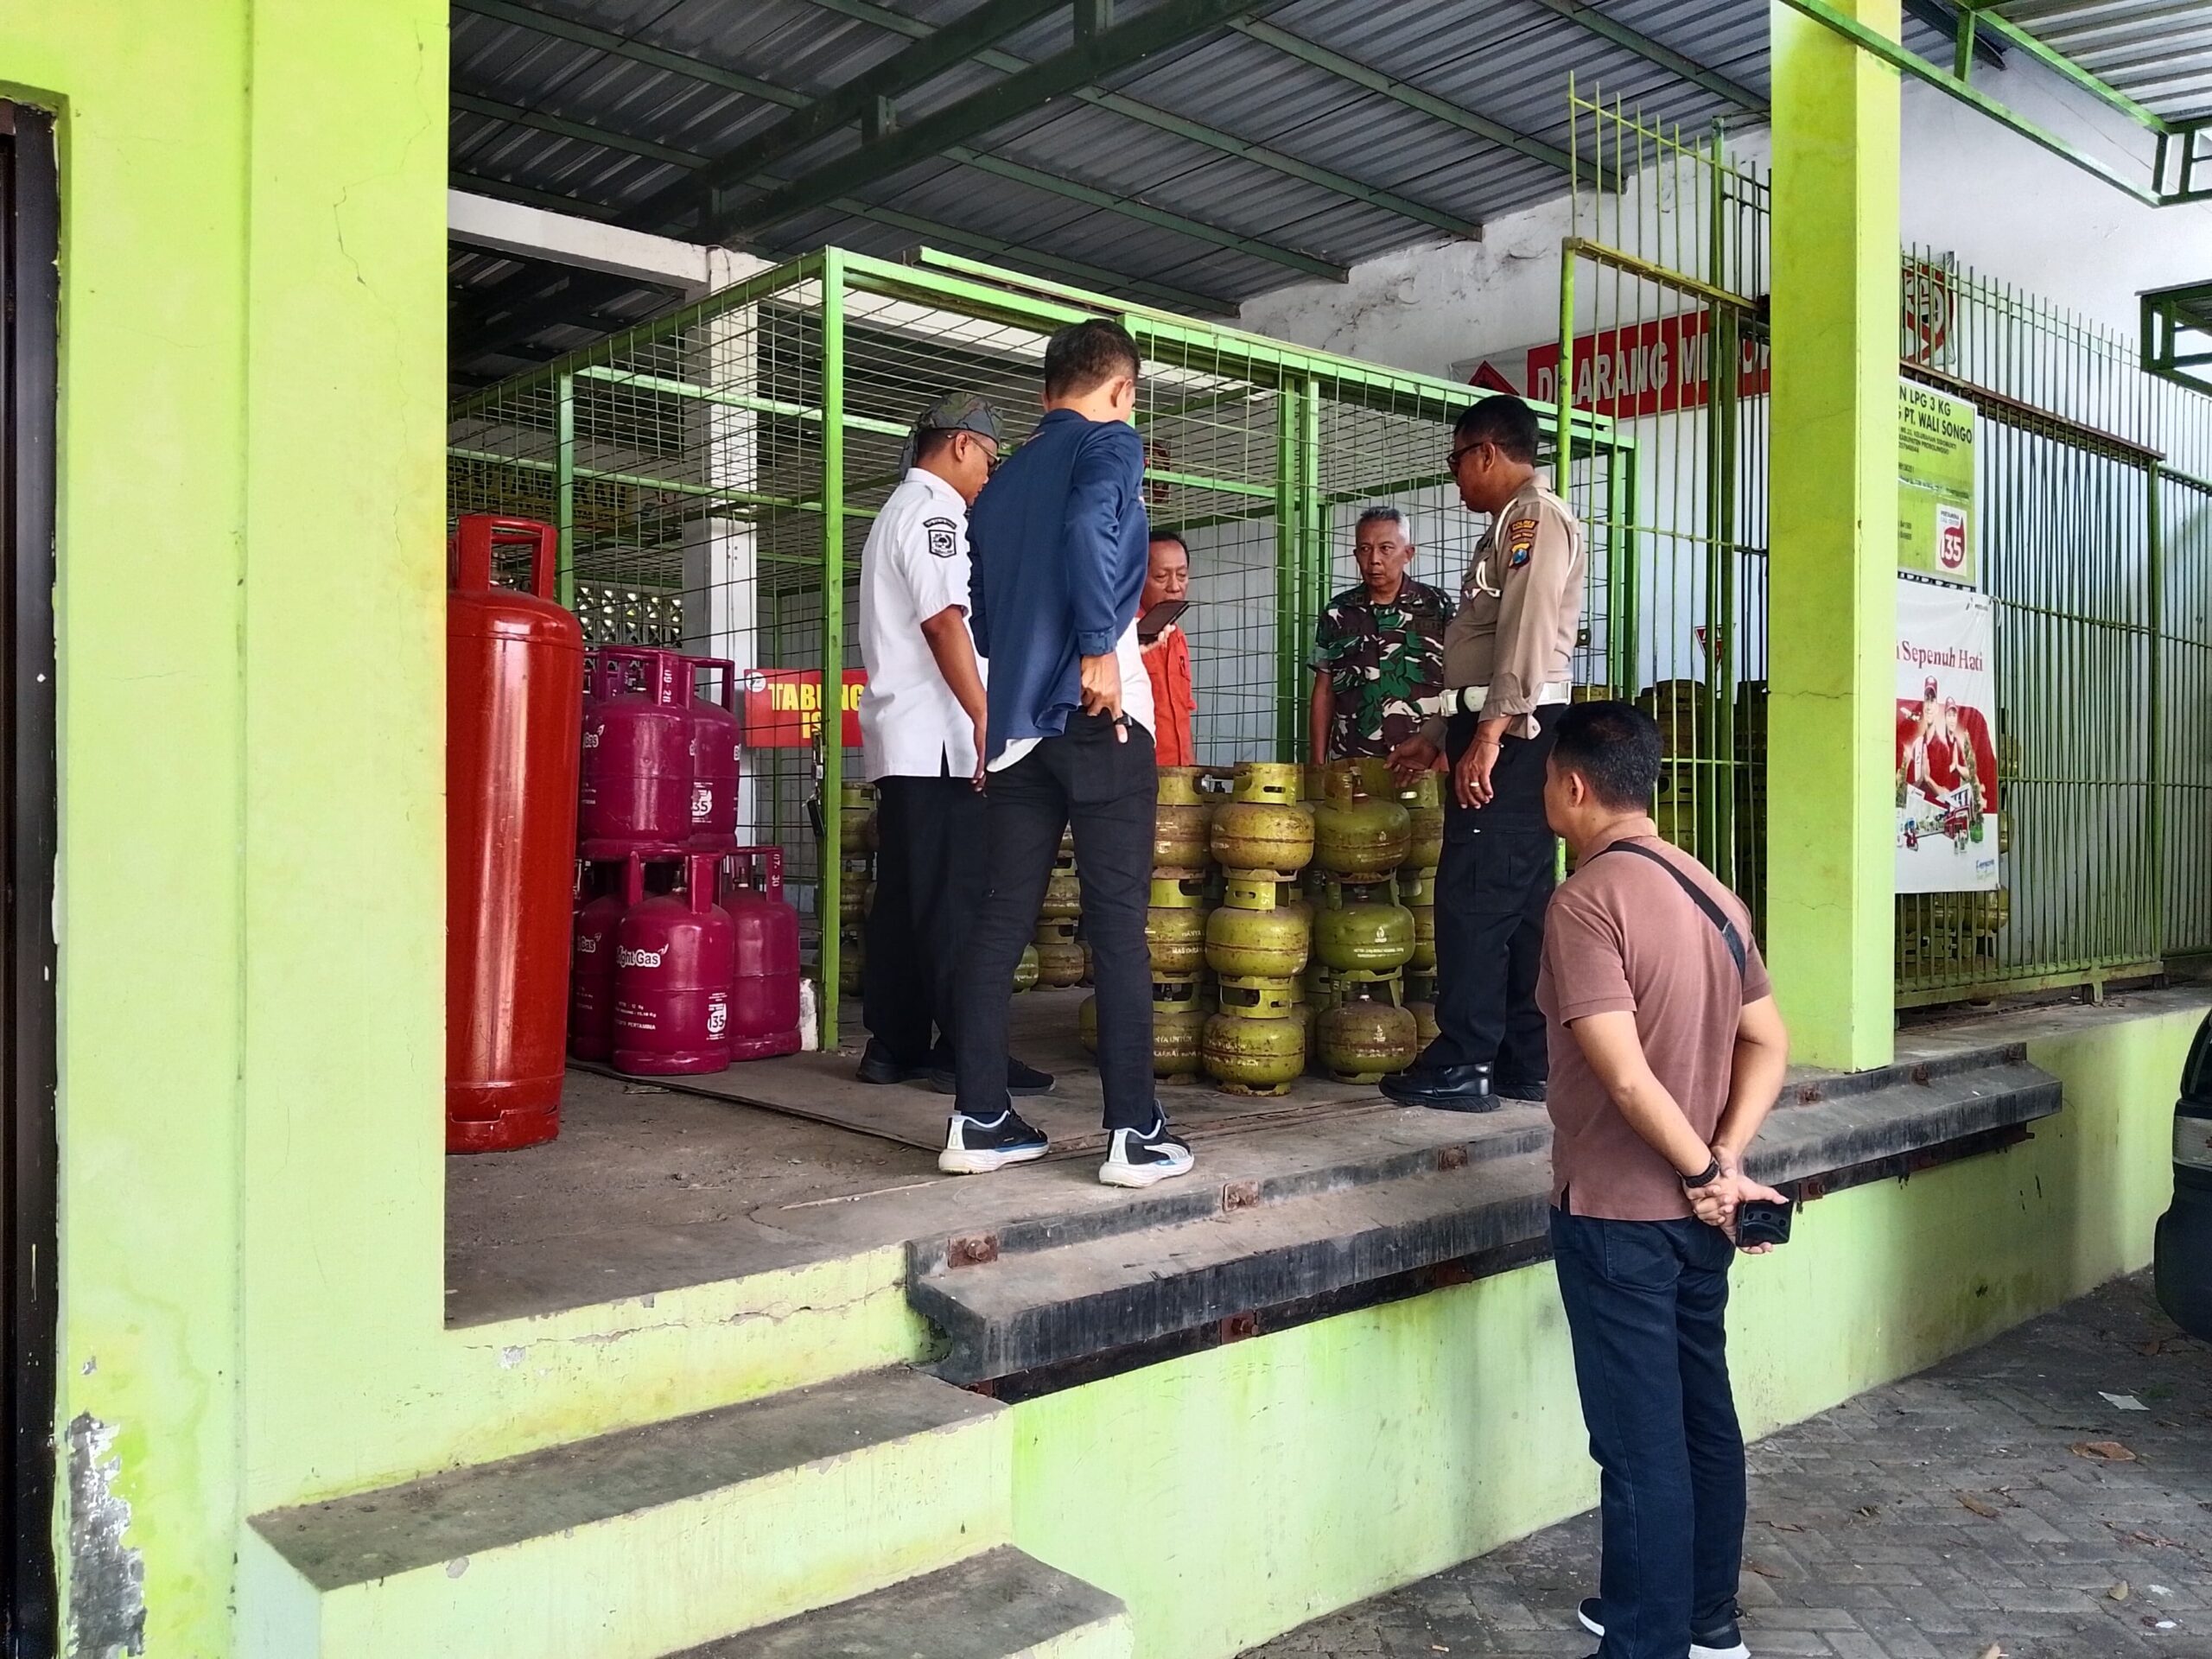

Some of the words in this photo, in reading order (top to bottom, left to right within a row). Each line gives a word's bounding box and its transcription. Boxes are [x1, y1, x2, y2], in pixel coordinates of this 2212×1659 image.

[1537, 341, 1669, 406] DIARANG
[1910, 389, 1928, 408] LPG
[1929, 396, 1936, 411] 3
[1938, 399, 1951, 416] KG
[1904, 406, 1916, 425] PT.
[1918, 410, 1940, 433] WALI
[1942, 419, 1973, 444] SONGO
[1941, 533, 1962, 563] 135
[1902, 640, 1956, 670] Sepenuh
[1959, 649, 1984, 672] Hati
[691, 800, 709, 812] 35
[635, 950, 659, 966] Gas
[709, 1015, 724, 1028] 135
